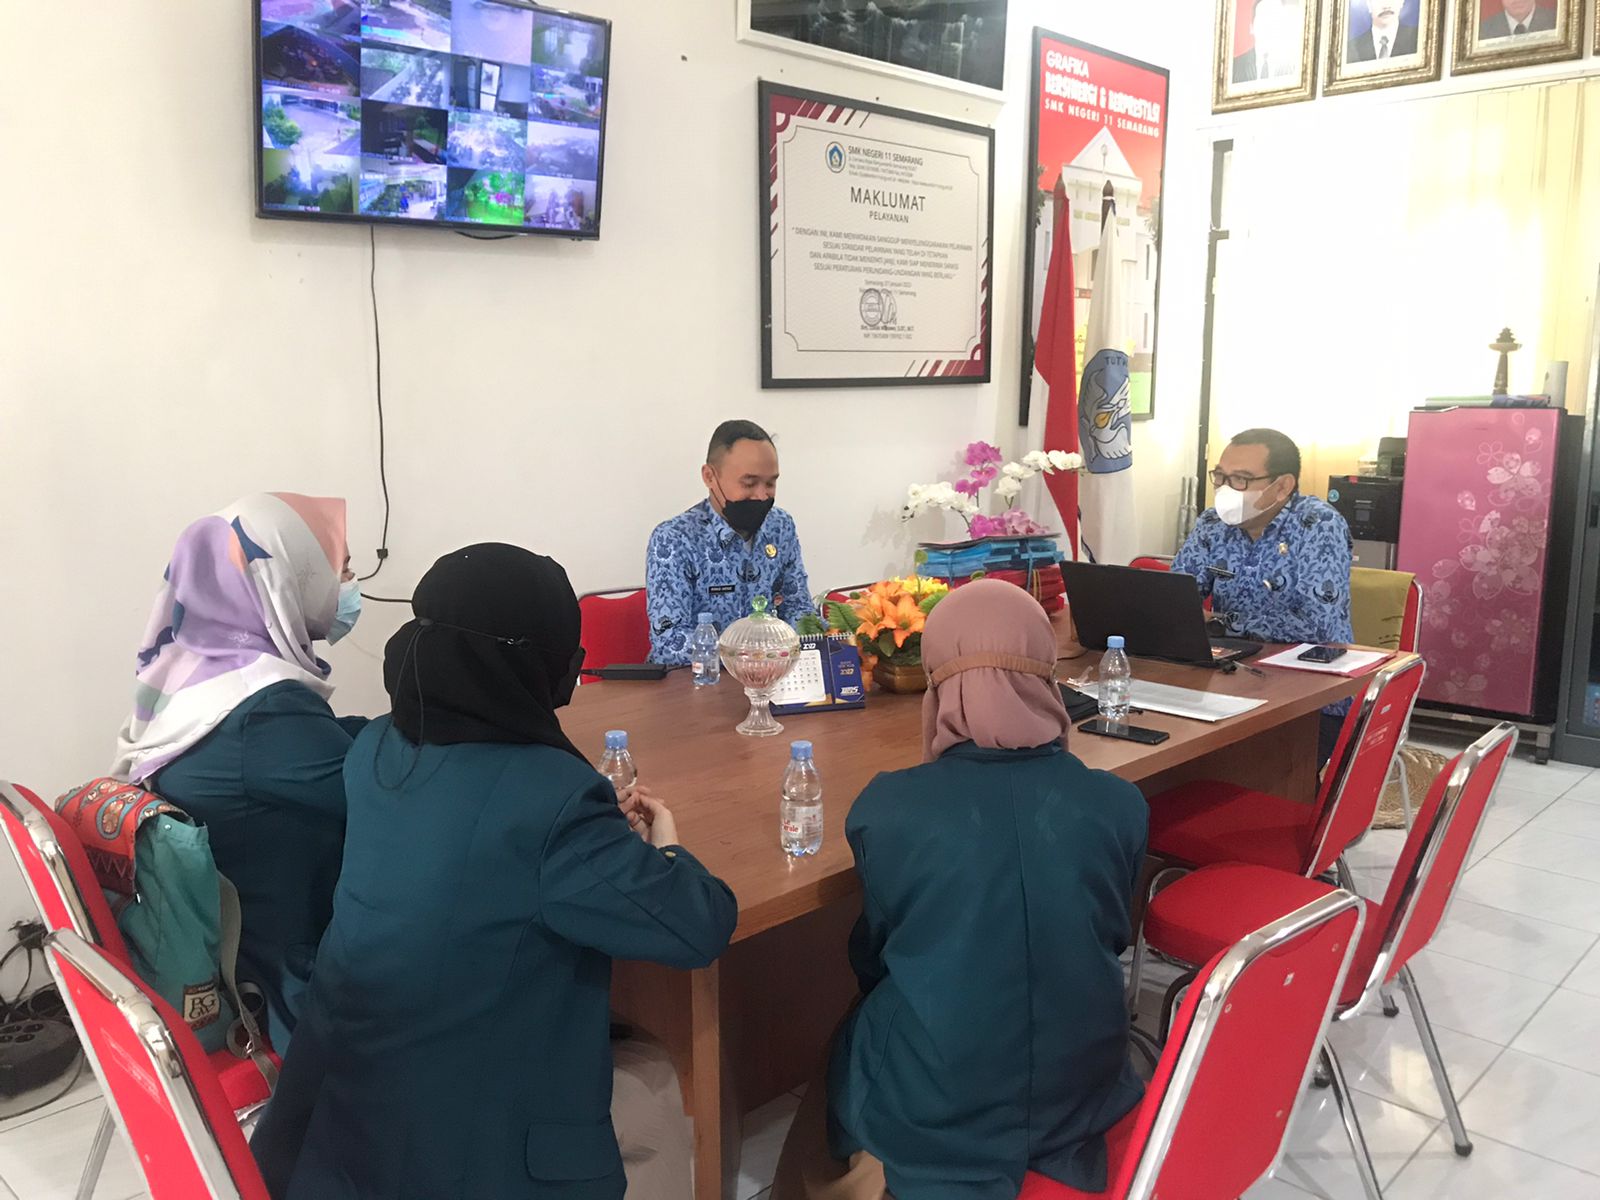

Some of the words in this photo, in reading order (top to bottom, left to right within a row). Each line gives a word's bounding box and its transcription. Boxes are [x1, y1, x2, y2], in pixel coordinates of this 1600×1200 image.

[1046, 50, 1089, 78] GRAFIKA
[1045, 98, 1064, 112] SMK
[1068, 104, 1099, 122] NEGERI
[1104, 114, 1113, 126] 11
[1117, 117, 1159, 138] SEMARANG
[848, 145, 861, 154] SMK
[862, 148, 884, 159] NEGERI
[885, 151, 892, 160] 11
[892, 153, 923, 166] SEMARANG
[850, 186, 926, 211] MAKLUMAT
[869, 210, 909, 223] PELAYANAN
[1105, 356, 1122, 366] TUT
